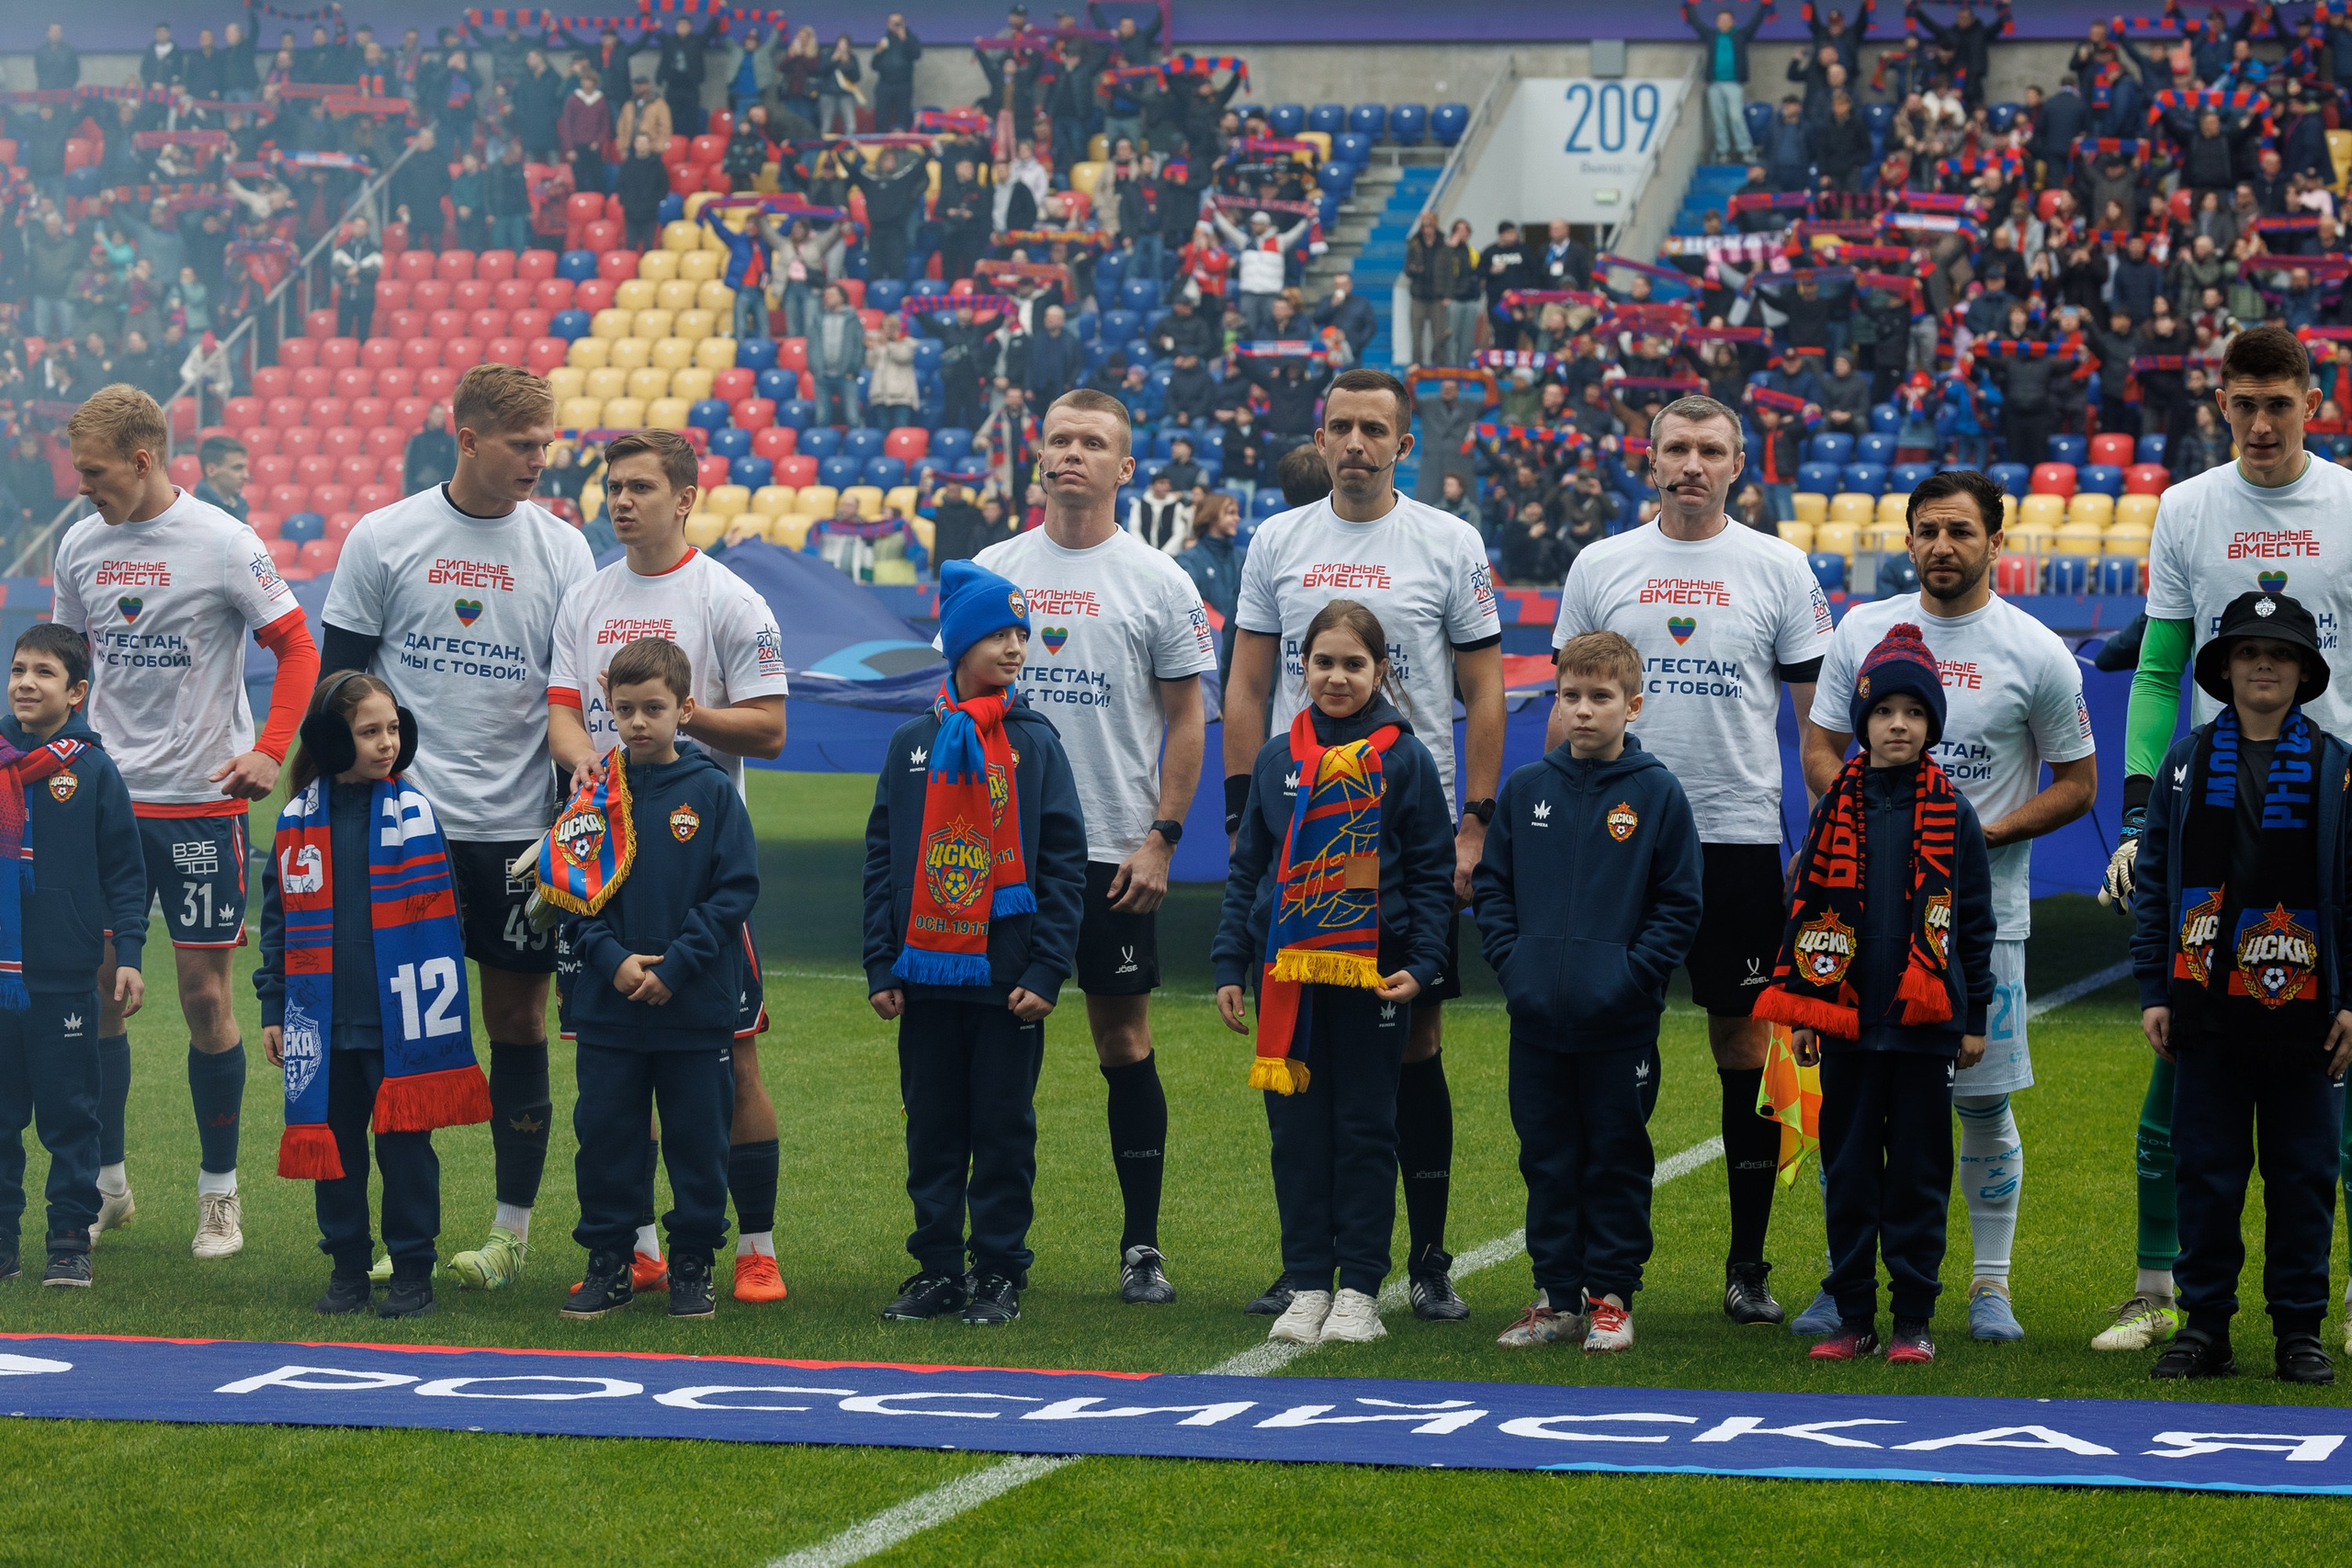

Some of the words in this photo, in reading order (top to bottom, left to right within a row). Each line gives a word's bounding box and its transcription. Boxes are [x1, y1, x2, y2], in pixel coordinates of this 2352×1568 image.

[1566, 83, 1659, 152] 209
[2234, 530, 2312, 543] СИЛЬНЫЕ
[2228, 541, 2320, 559] ВМЕСТЕ
[102, 560, 166, 571] СИЛЬНЫЕ
[252, 562, 266, 577] 20
[436, 558, 509, 575] СИЛЬНЫЕ
[1312, 563, 1385, 575] СИЛЬНЫЕ
[96, 571, 171, 587] ВМЕСТЕ
[258, 573, 272, 588] 26
[428, 569, 514, 592] ВМЕСТЕ
[1303, 573, 1391, 590] ВМЕСТЕ
[1472, 574, 1485, 589] 20
[1647, 579, 1724, 592] СИЛЬНЫЕ
[1025, 589, 1095, 602] СИЛЬНЫЕ
[1475, 586, 1488, 601] 26
[1639, 590, 1731, 606] ВМЕСТЕ
[1027, 599, 1101, 617] МЕСТЕ
[1814, 604, 1825, 618] 26
[605, 618, 673, 629] СИЛЬНЫЕ
[1191, 612, 1204, 626] 20
[1194, 624, 1209, 637] 26
[403, 632, 526, 664] ДАГЕСТАН,
[757, 635, 772, 647] 20
[123, 653, 191, 667] ТОБОЙ!
[758, 647, 774, 660] 26
[400, 652, 428, 670] МЫ
[434, 659, 446, 672] С
[450, 660, 526, 682] ТОБОЙ!
[1642, 658, 1741, 681] ГЕСТАН,
[1016, 667, 1112, 691] ГЕСТАН,
[1648, 681, 1661, 694] С
[1664, 680, 1742, 698] ТОБОЙ!
[1040, 689, 1111, 707] ТОБОЙ!
[1940, 763, 1992, 780] БОЙ!
[51, 776, 75, 786] ЦСКА
[671, 814, 698, 827] ЦСКА
[1610, 813, 1634, 825] ЦСКА
[558, 814, 603, 842] ЦСКА
[173, 840, 217, 858] ВЭБ
[929, 843, 985, 870] ЦСКА
[180, 882, 212, 928] 31
[1798, 931, 1849, 955] ЦСКА
[2242, 935, 2311, 965] ЦСКА
[1740, 976, 1770, 986] JÖGEL
[390, 956, 462, 1041] 12
[284, 1031, 315, 1057] СКА
[1735, 1159, 1776, 1169] JÖGEL
[214, 1364, 2347, 1462] РОССИЙСКАЯ
